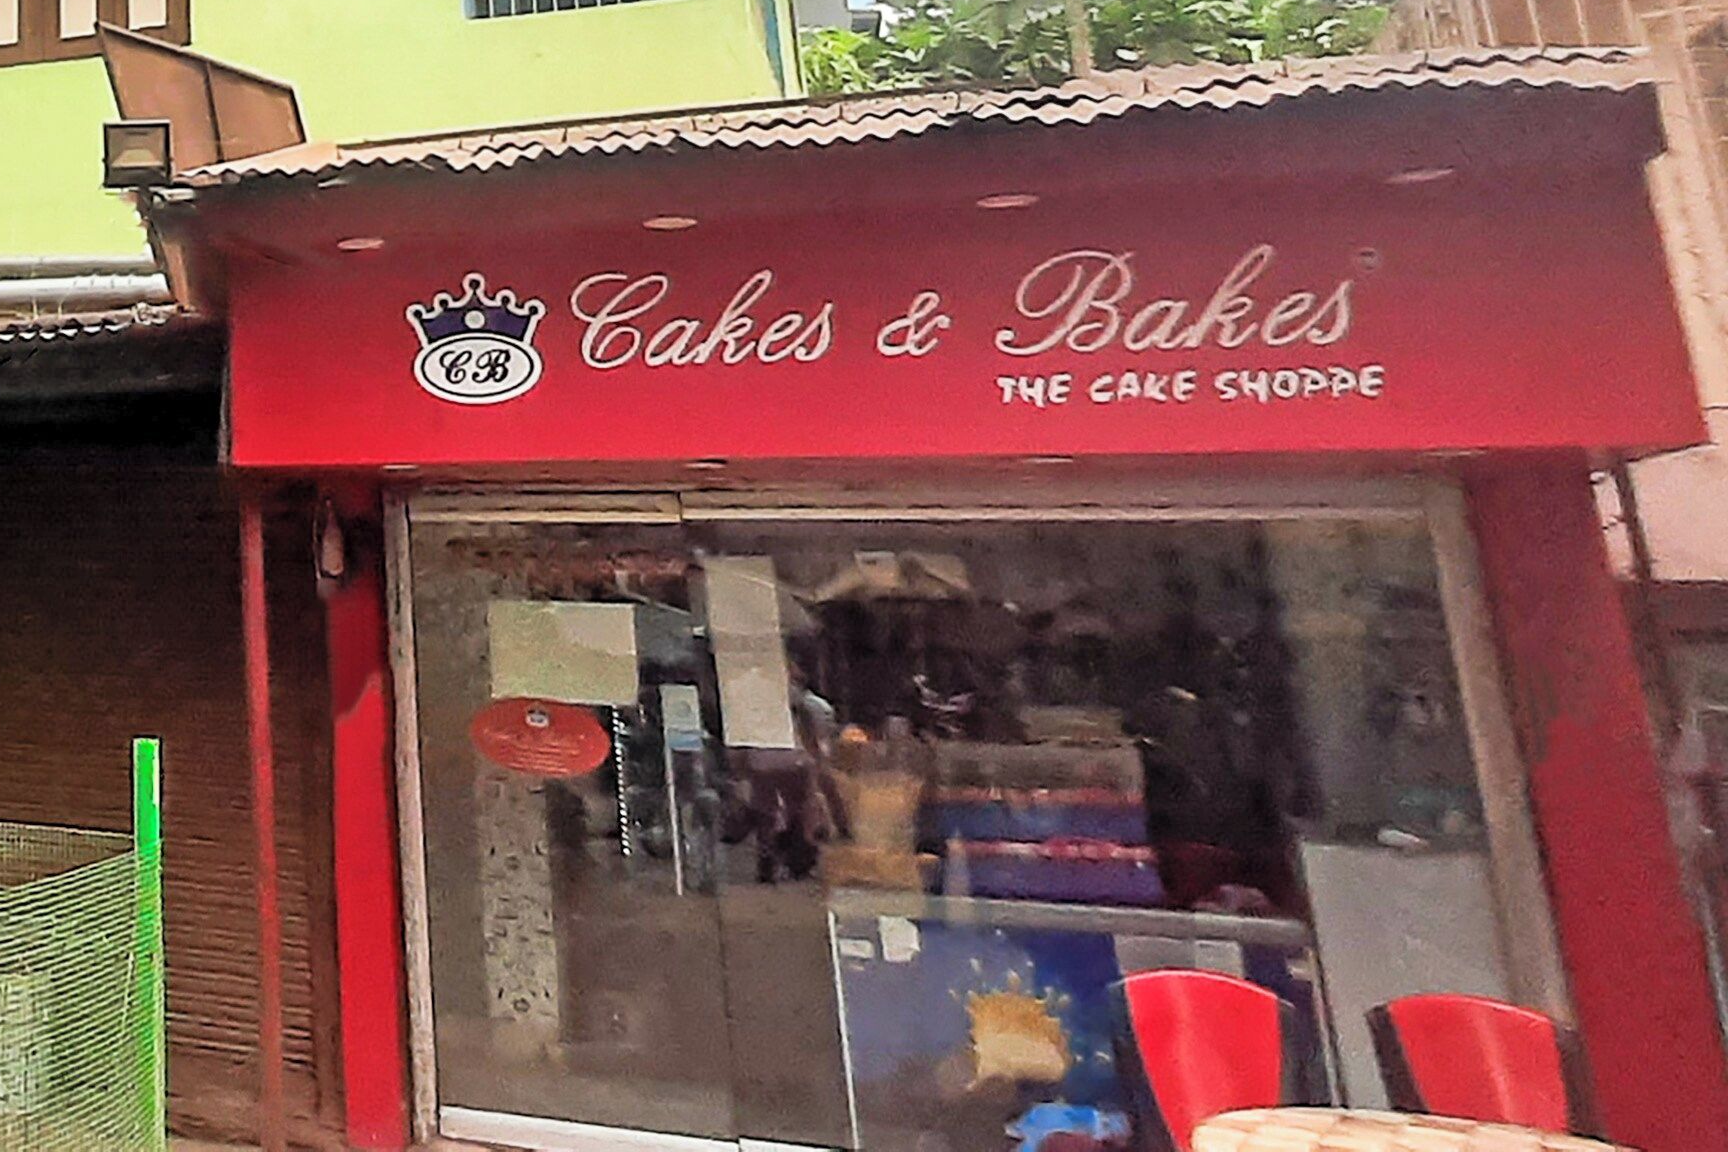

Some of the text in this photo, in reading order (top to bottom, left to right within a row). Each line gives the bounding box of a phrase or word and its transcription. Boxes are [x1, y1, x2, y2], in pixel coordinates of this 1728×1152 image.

[571, 244, 1354, 369] Cakes & Bakes
[996, 365, 1384, 407] THE CAKE SHOPPE
